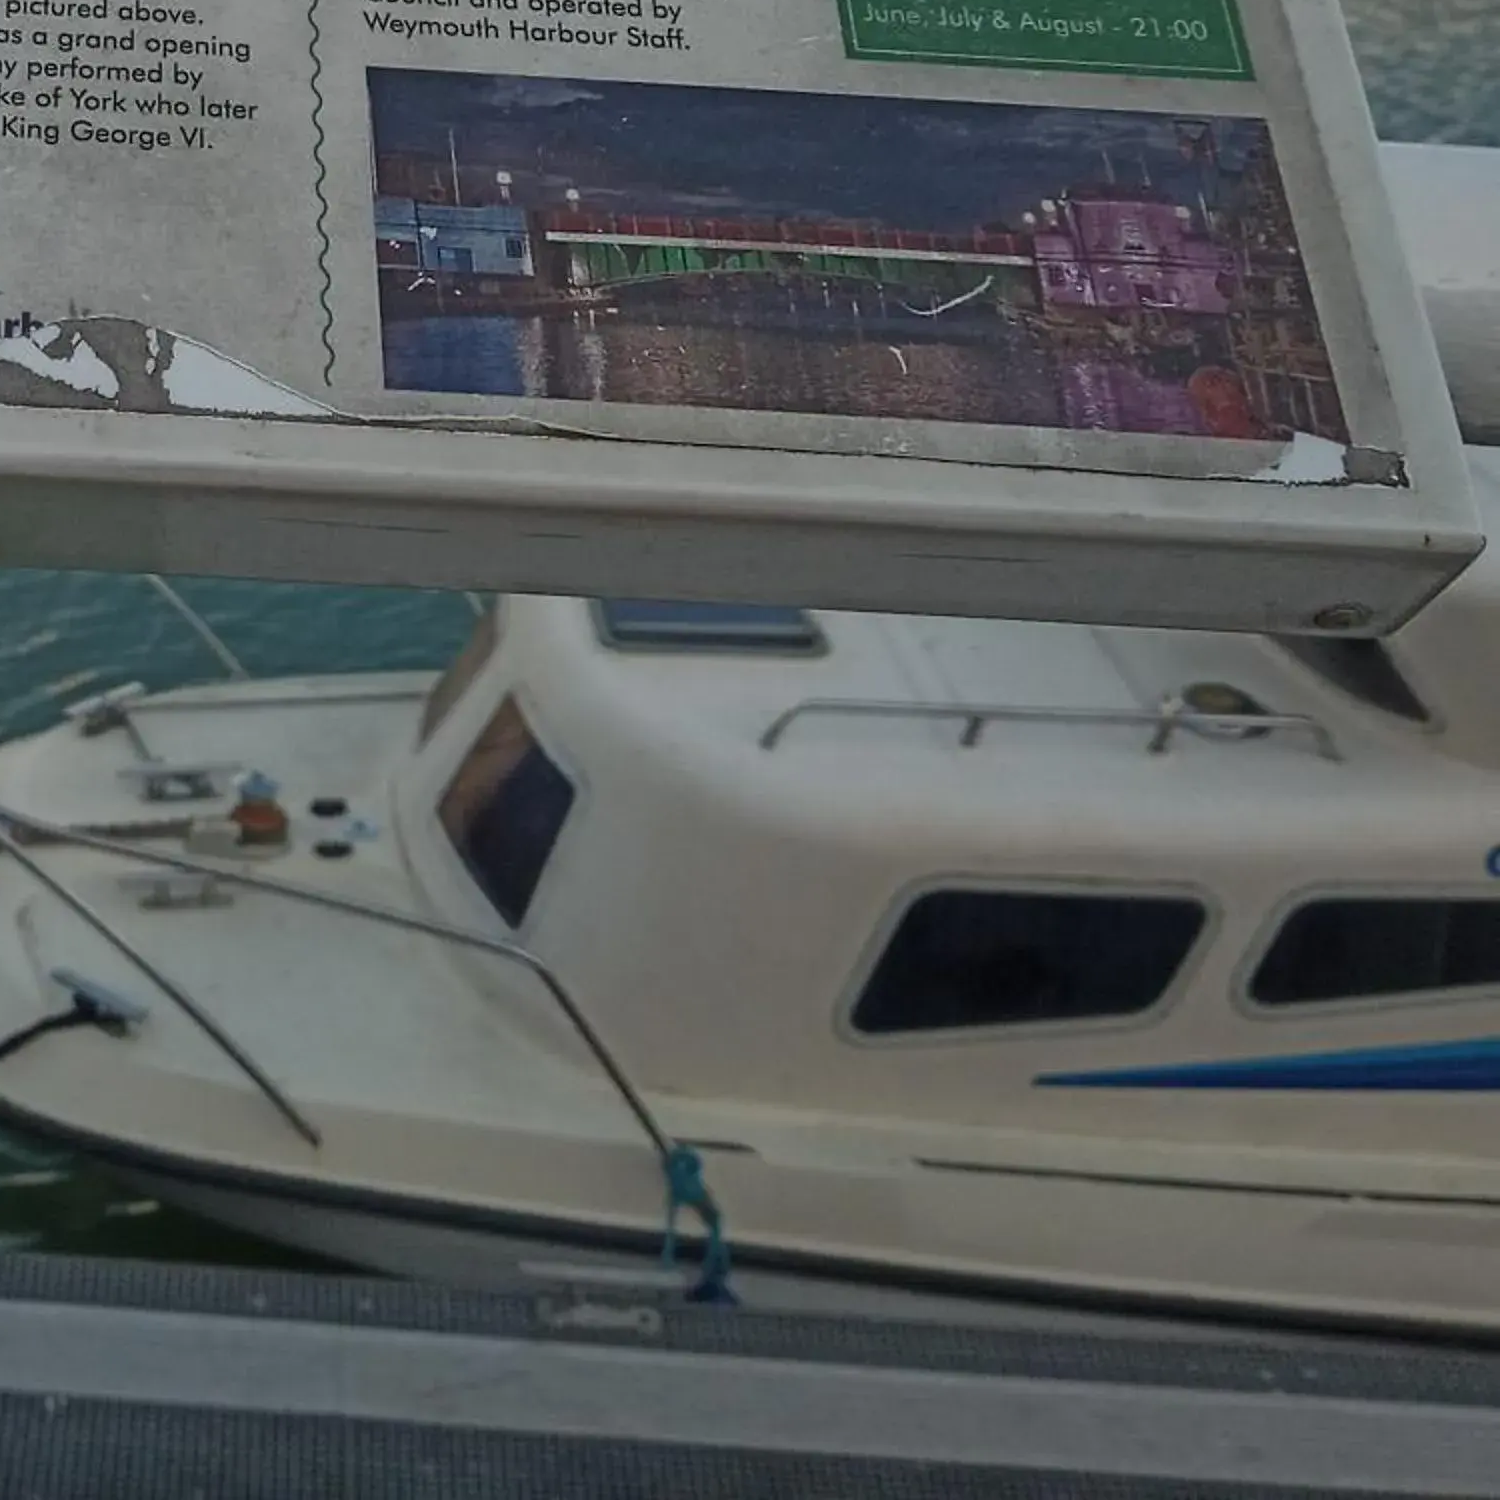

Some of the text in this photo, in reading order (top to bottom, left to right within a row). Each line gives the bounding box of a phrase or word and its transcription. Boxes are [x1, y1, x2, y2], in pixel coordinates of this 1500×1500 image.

[362, 10, 691, 51] Weymouth Harbour Staff.
[937, 5, 983, 32] July
[992, 10, 1011, 29] &
[1020, 12, 1105, 37] August
[1, 112, 59, 146] King
[69, 118, 171, 151] George
[178, 125, 213, 149] VI.
